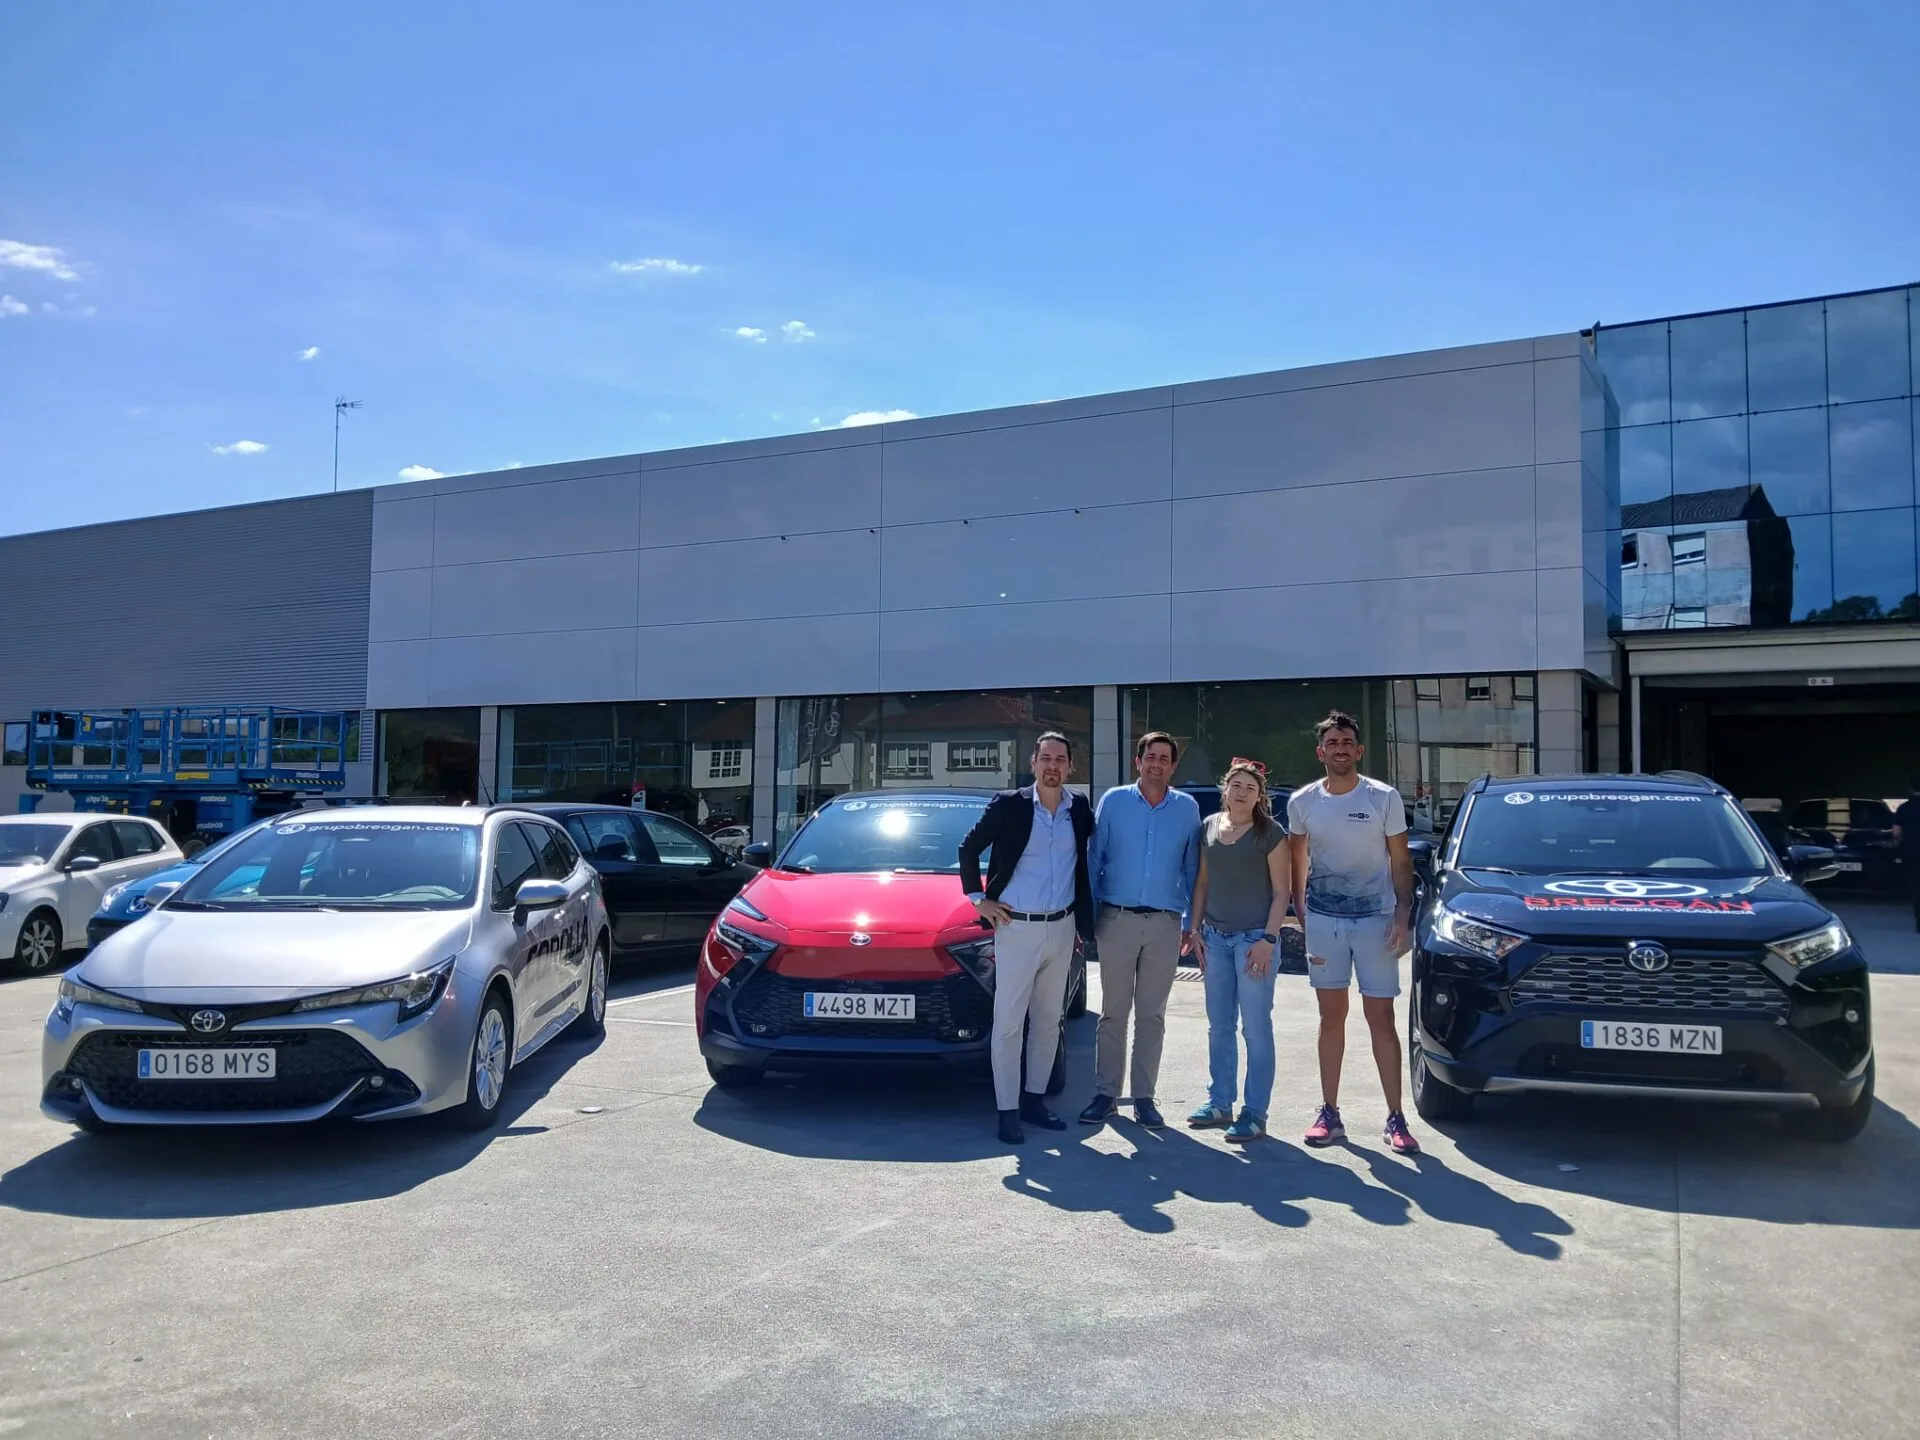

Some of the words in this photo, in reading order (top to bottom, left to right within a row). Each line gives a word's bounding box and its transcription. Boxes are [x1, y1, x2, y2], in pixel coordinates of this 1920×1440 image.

[1539, 792, 1702, 803] grupobreogan.com
[307, 823, 461, 833] grupobreogan.com
[817, 996, 867, 1016] 4498
[873, 997, 912, 1017] MZT
[1601, 1025, 1661, 1048] 1836
[1669, 1028, 1717, 1051] MZN
[154, 1053, 214, 1075] 0168
[223, 1052, 270, 1074] MYS
